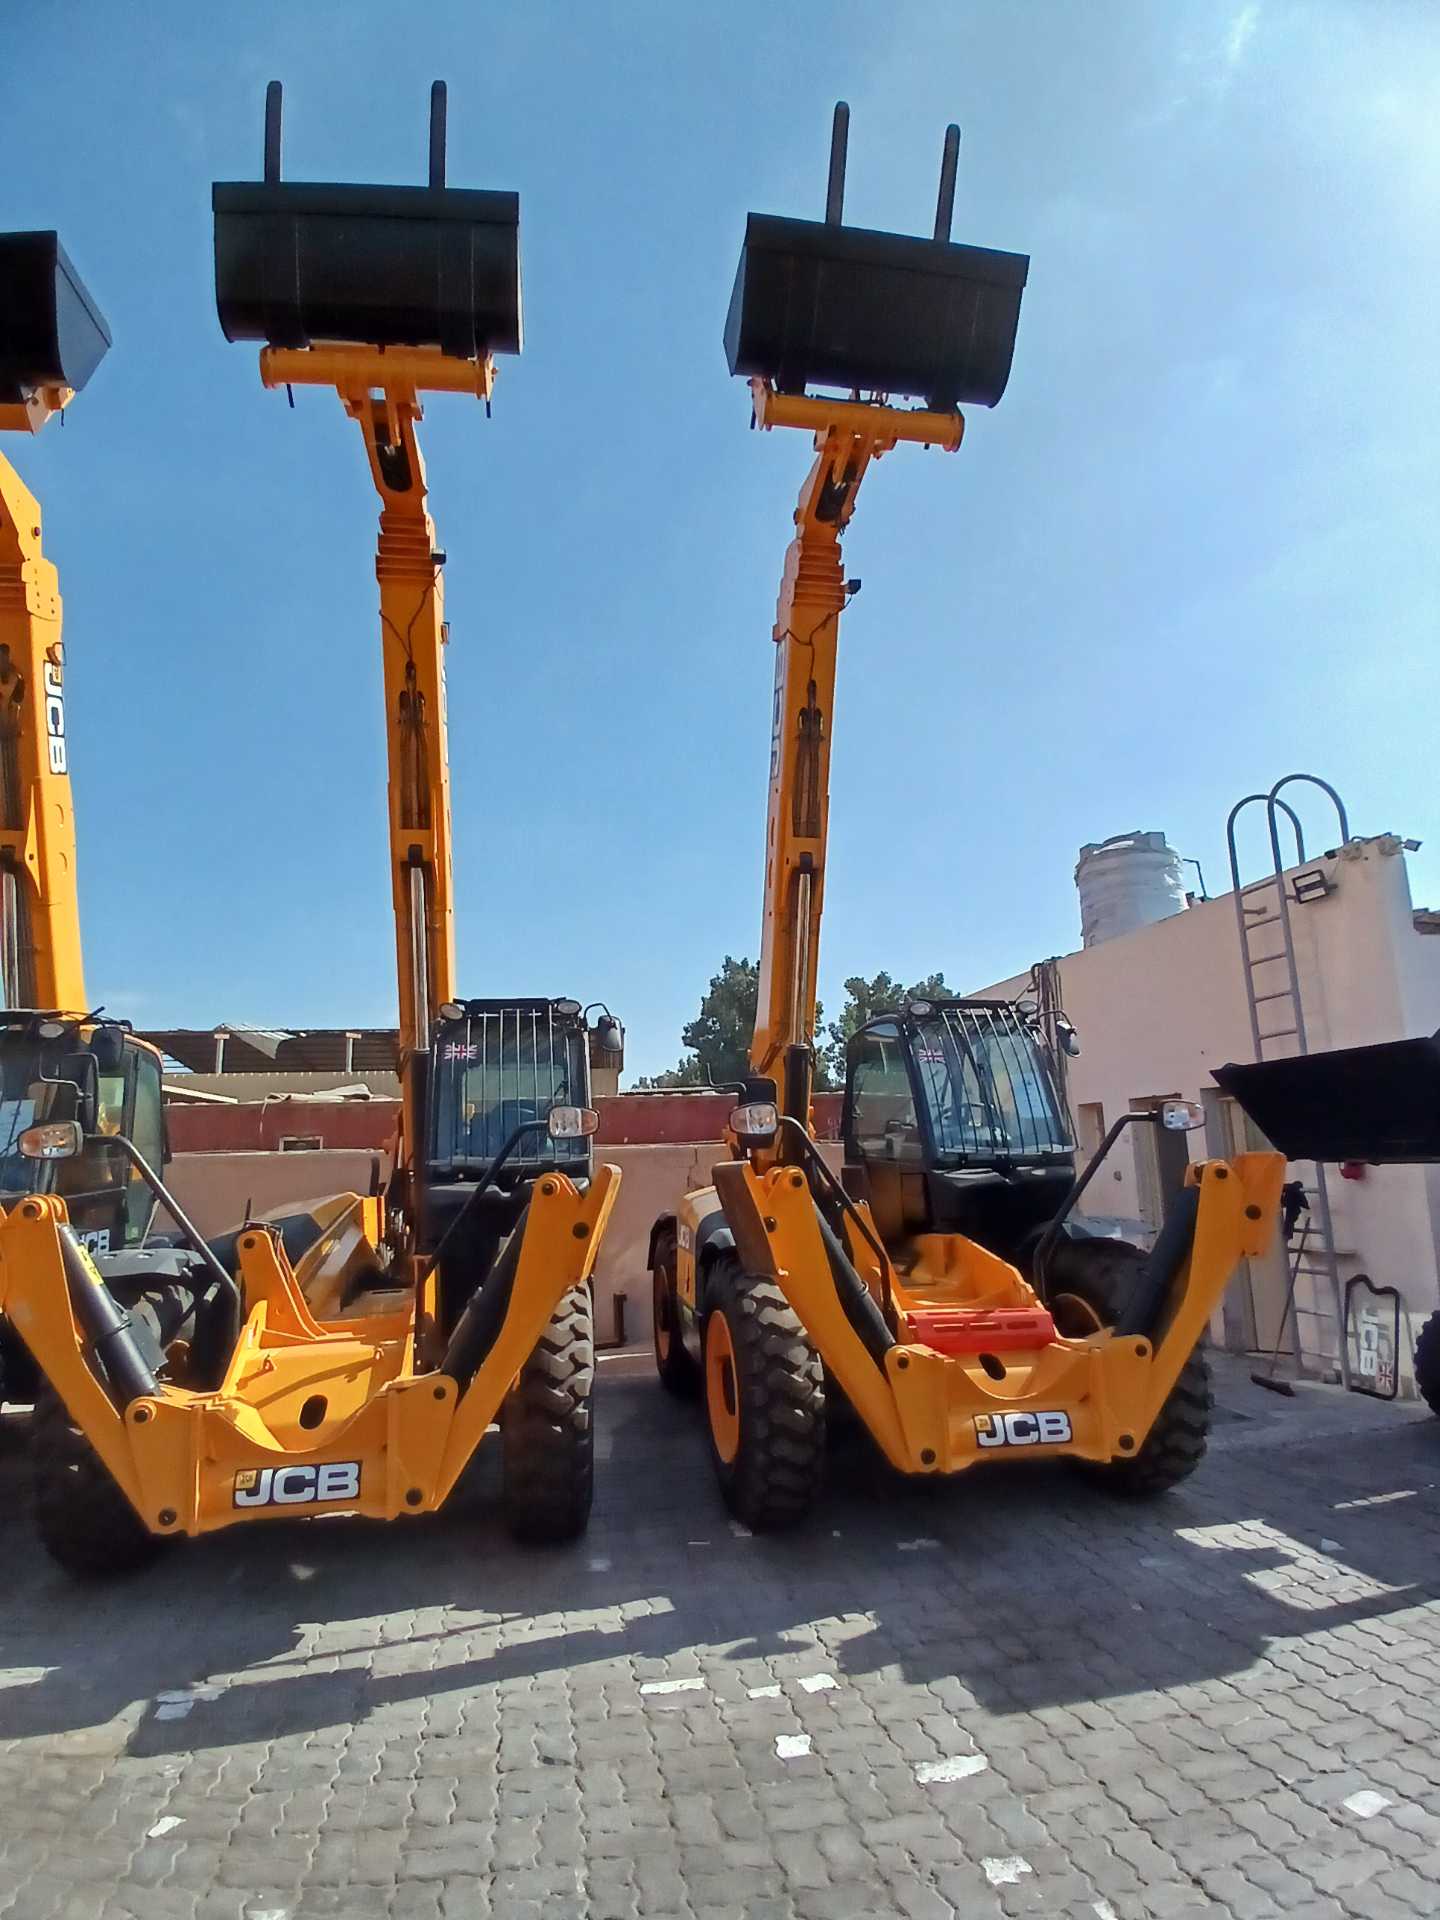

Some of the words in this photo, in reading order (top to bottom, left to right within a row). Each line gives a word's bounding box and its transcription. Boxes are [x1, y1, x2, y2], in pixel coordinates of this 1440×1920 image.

[44, 661, 67, 773] JCB
[978, 1411, 1071, 1446] JCB
[235, 1462, 359, 1506] JCB
